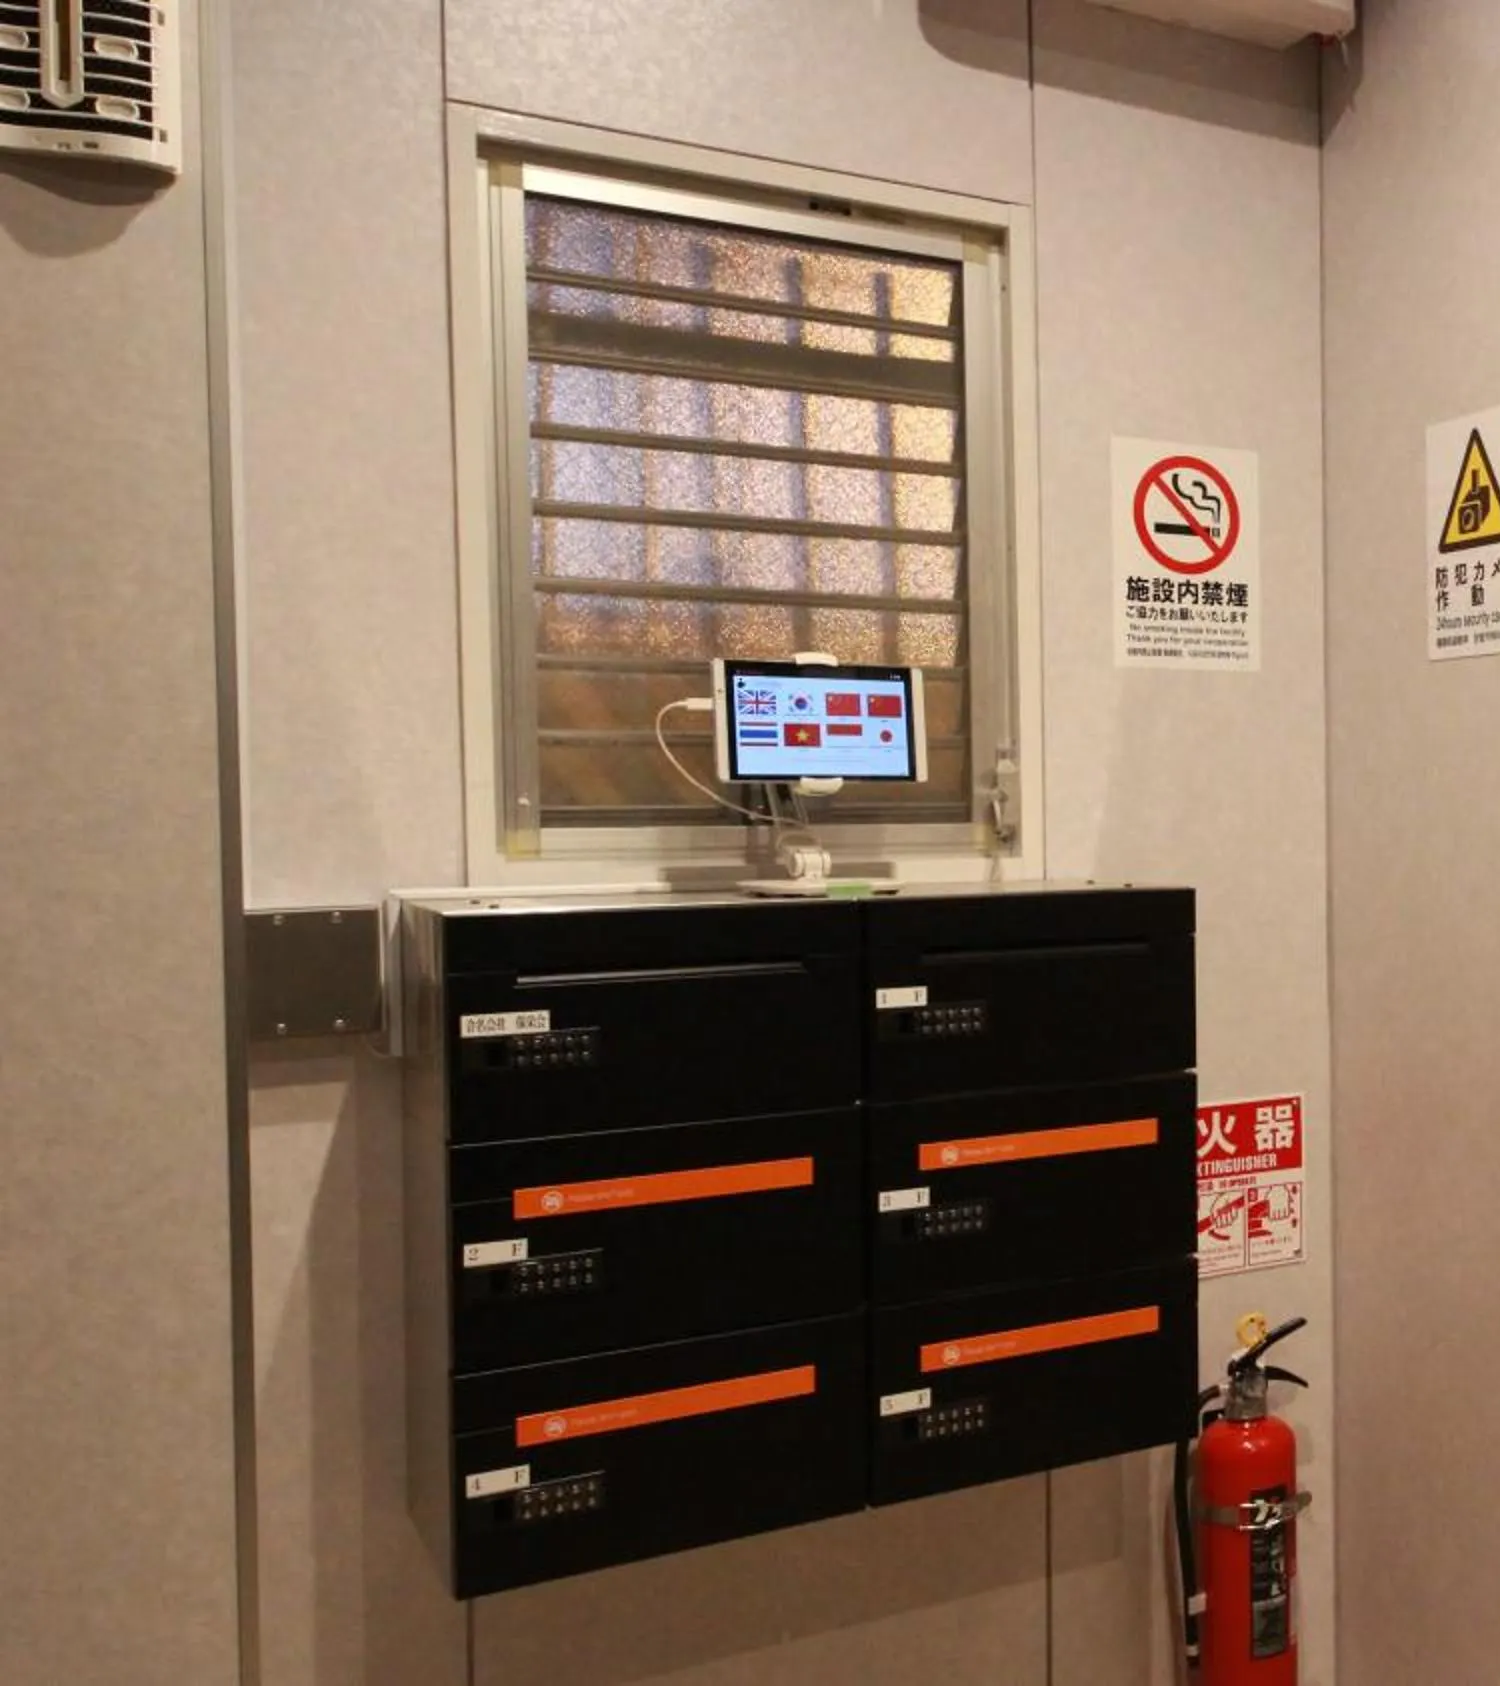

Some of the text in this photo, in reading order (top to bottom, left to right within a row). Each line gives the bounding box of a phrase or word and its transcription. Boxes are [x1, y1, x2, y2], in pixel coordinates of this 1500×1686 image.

[1126, 576, 1249, 607] 施設内禁煙
[1197, 1104, 1296, 1158] 火器
